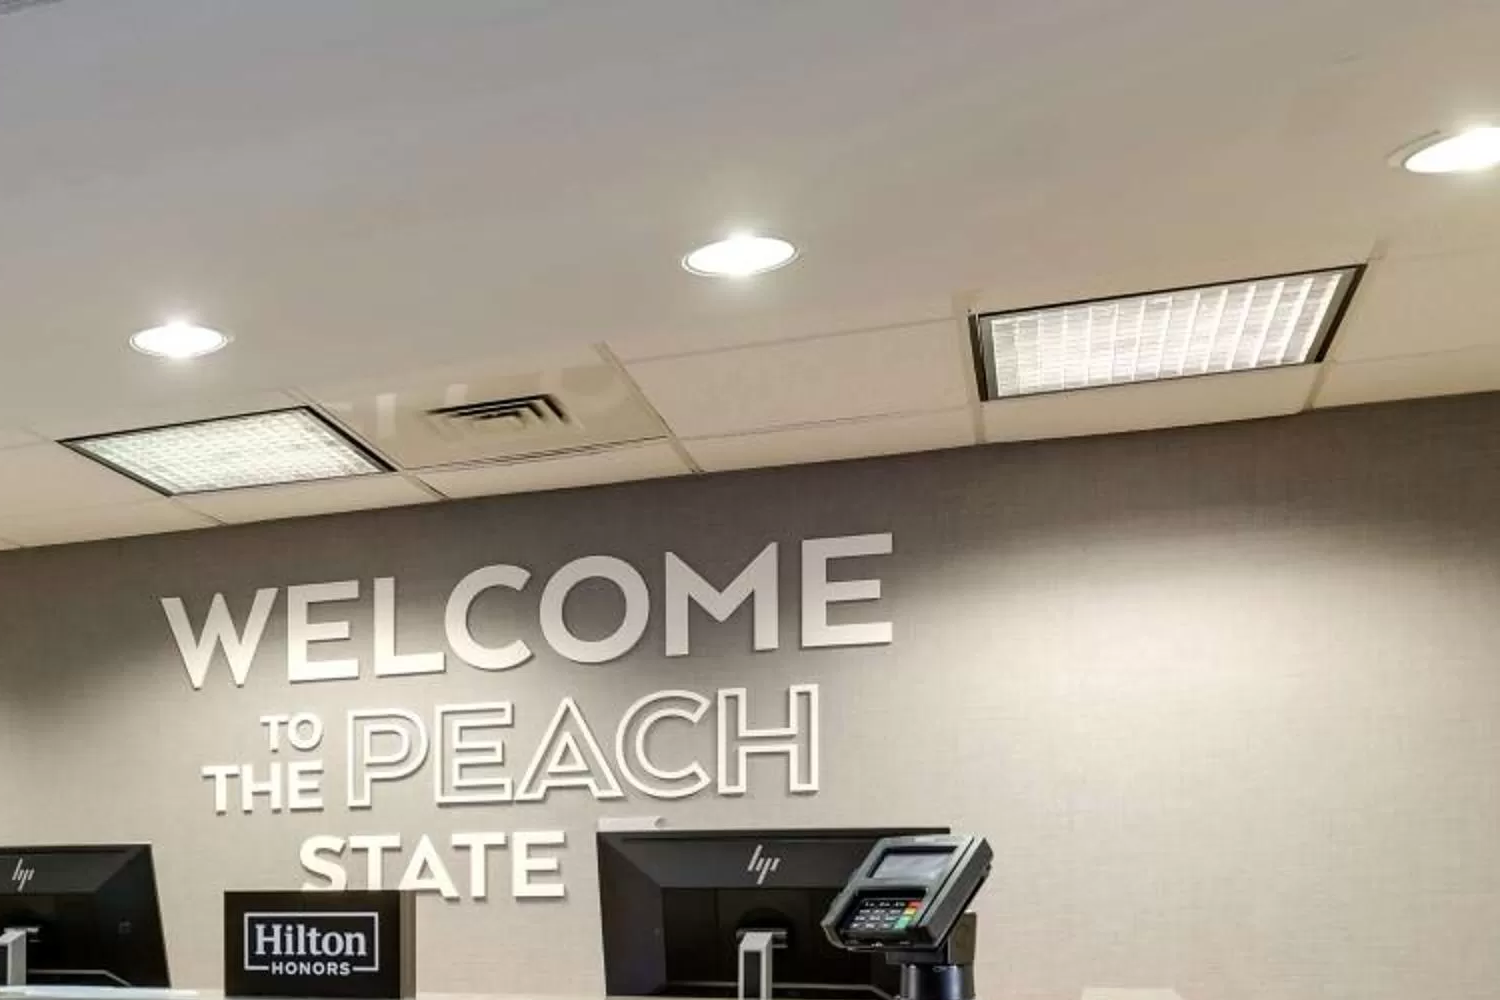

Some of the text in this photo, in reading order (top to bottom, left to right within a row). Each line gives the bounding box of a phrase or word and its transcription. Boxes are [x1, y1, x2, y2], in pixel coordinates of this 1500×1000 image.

[161, 533, 893, 688] WELCOME
[202, 684, 820, 815] THE PEACH
[260, 713, 324, 752] TO
[12, 857, 35, 891] hp
[299, 831, 565, 900] STATE
[747, 844, 781, 885] hp
[255, 924, 368, 956] Hilton
[271, 961, 351, 976] HONORS
